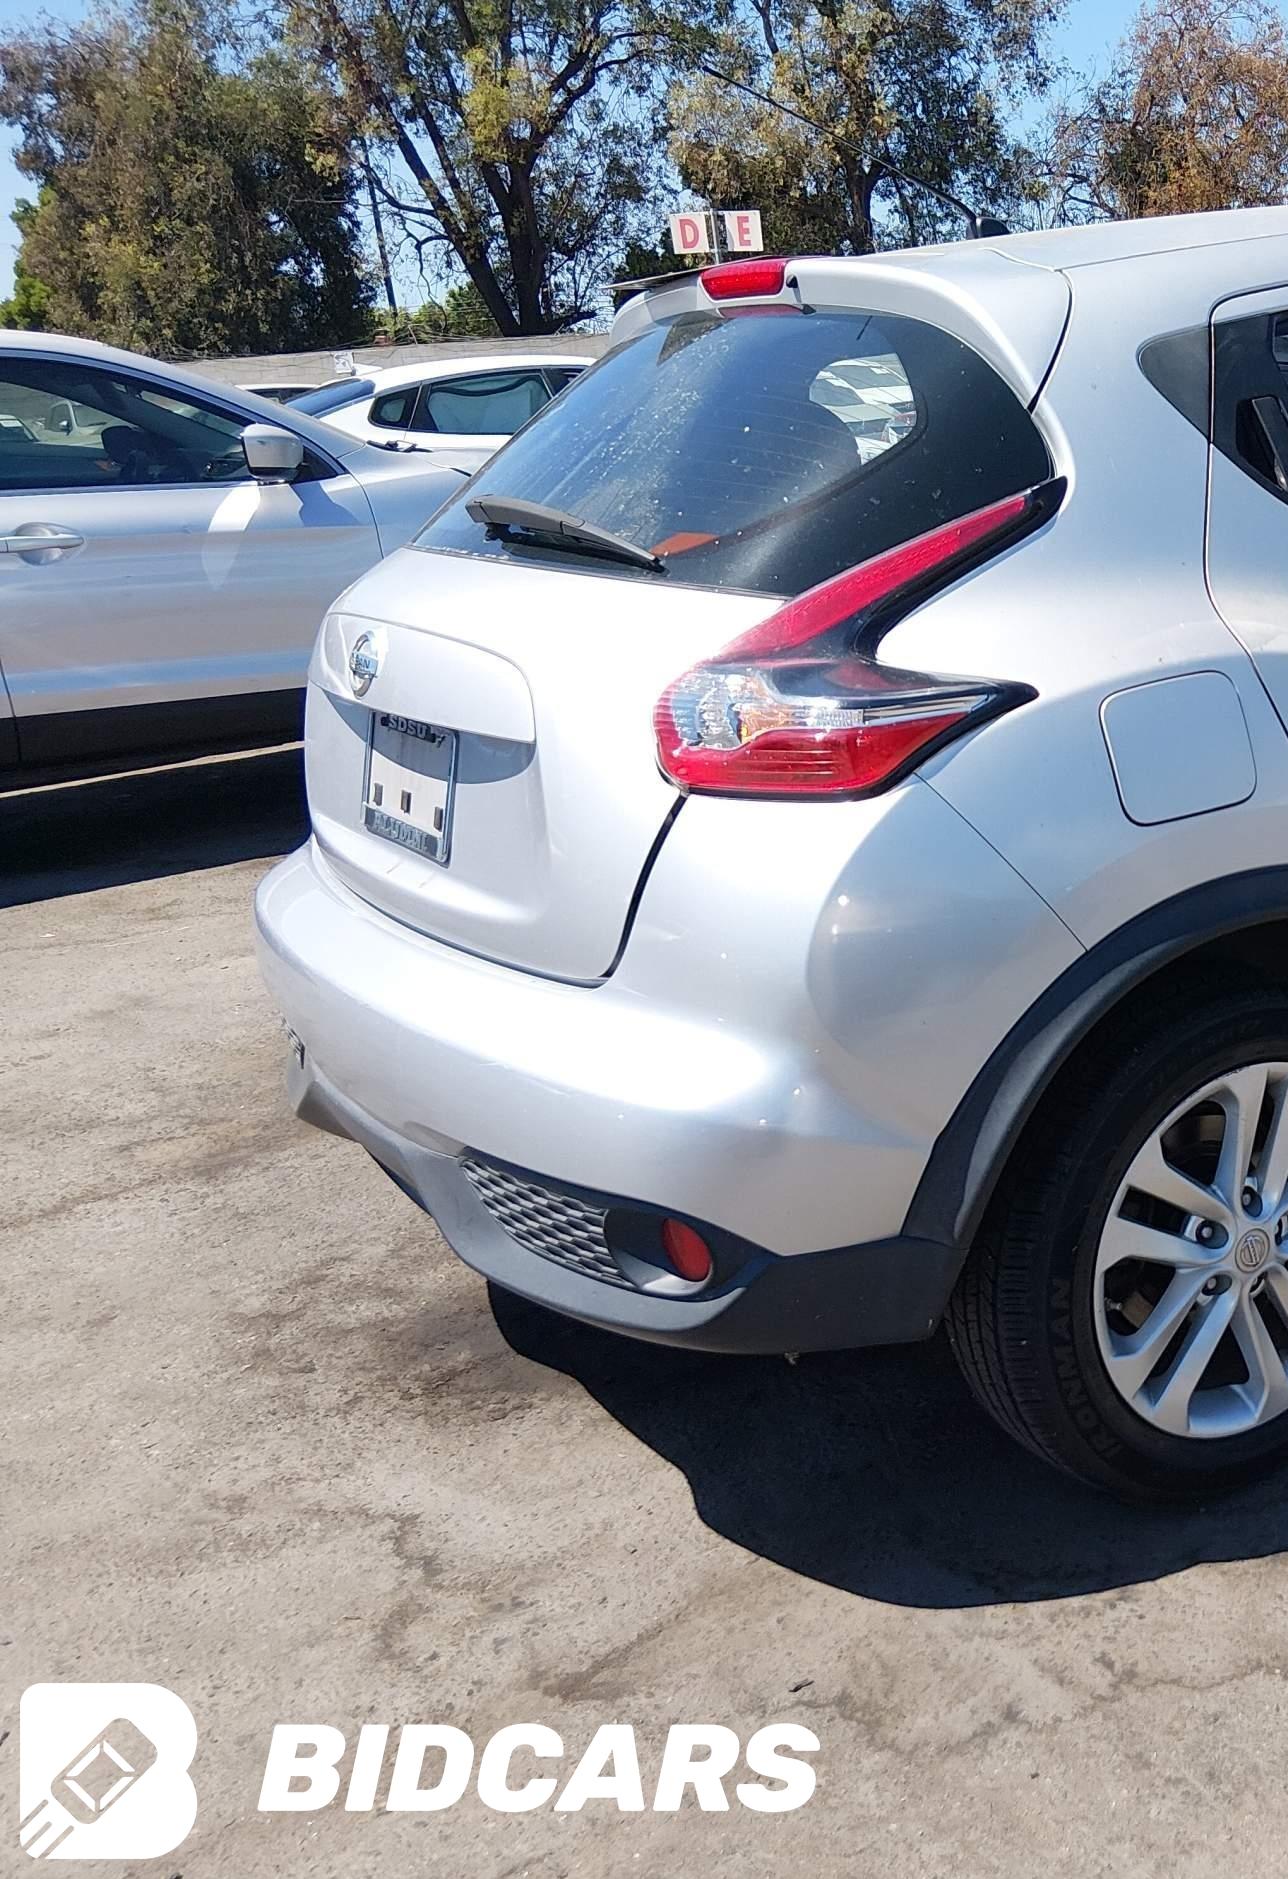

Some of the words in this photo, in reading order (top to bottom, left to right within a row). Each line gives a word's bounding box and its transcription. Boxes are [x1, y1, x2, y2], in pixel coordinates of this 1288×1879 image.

[679, 218, 700, 249] D
[736, 216, 752, 247] E
[388, 714, 428, 739] SDSU
[1052, 1278, 1124, 1464] IRONMAN
